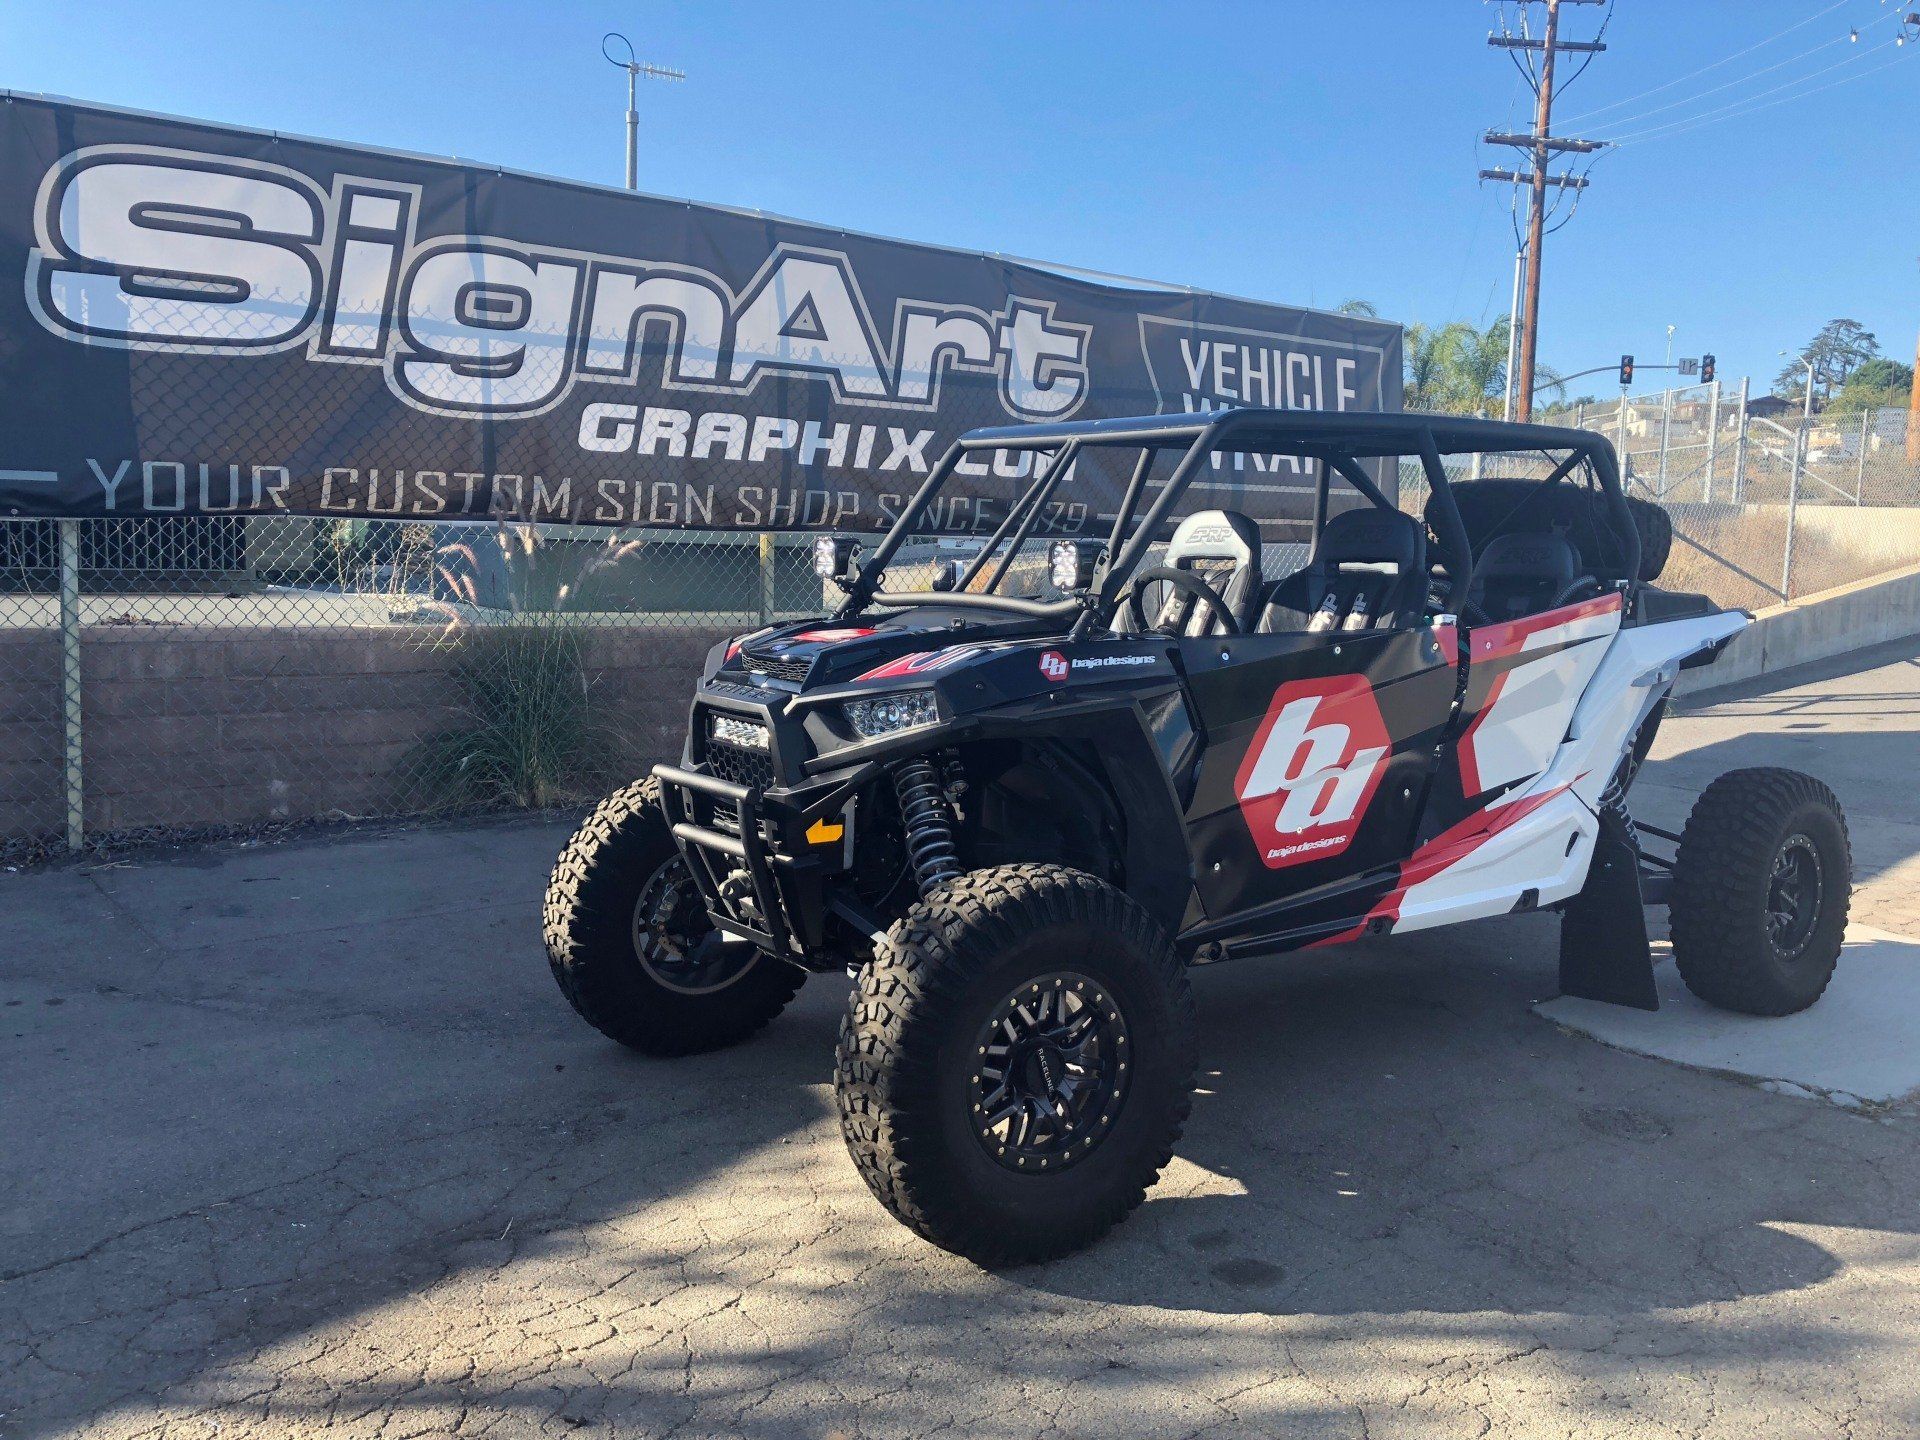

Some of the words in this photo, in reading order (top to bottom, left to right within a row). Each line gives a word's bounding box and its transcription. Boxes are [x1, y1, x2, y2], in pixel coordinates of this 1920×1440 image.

[25, 143, 1093, 420] SignArt
[86, 459, 289, 510] YOUR
[320, 468, 571, 518] CUSTOM
[595, 479, 714, 525] SIGN
[735, 487, 859, 527] SHOP
[875, 493, 993, 531] SNCE
[1005, 500, 1087, 533] 79
[1072, 658, 1102, 669] baja
[1103, 655, 1156, 668] designs
[1267, 845, 1295, 860] baja
[1296, 835, 1347, 853] designs
[1038, 1048, 1054, 1093] RACELINE
